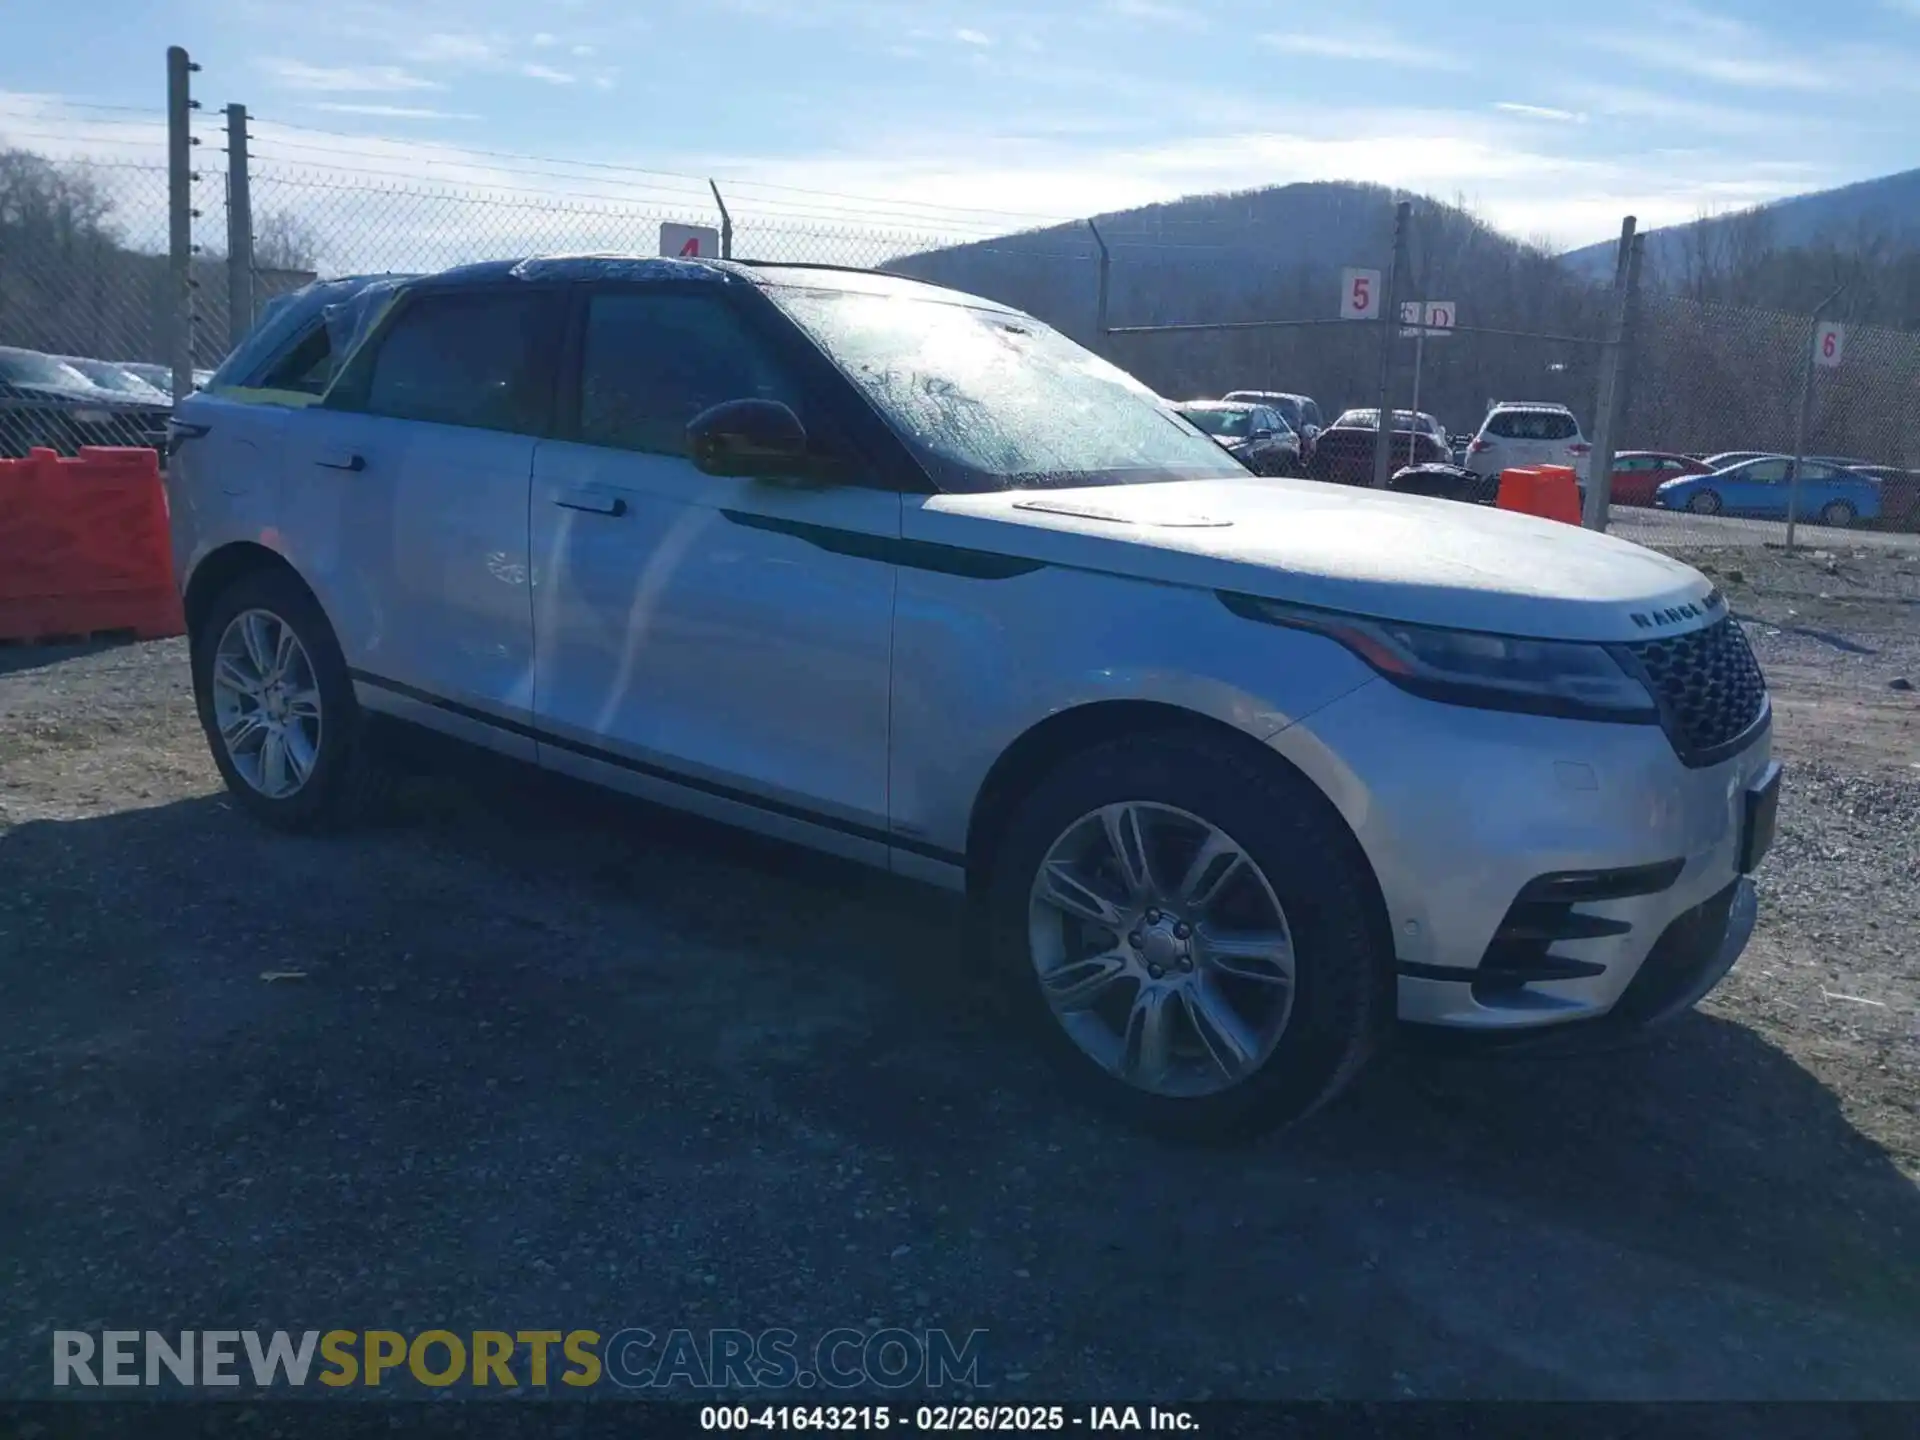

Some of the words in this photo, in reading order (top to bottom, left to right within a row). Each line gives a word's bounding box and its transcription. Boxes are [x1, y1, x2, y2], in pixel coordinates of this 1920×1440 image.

[1353, 278, 1369, 310] 5
[1432, 308, 1450, 328] D
[1823, 332, 1836, 358] 6
